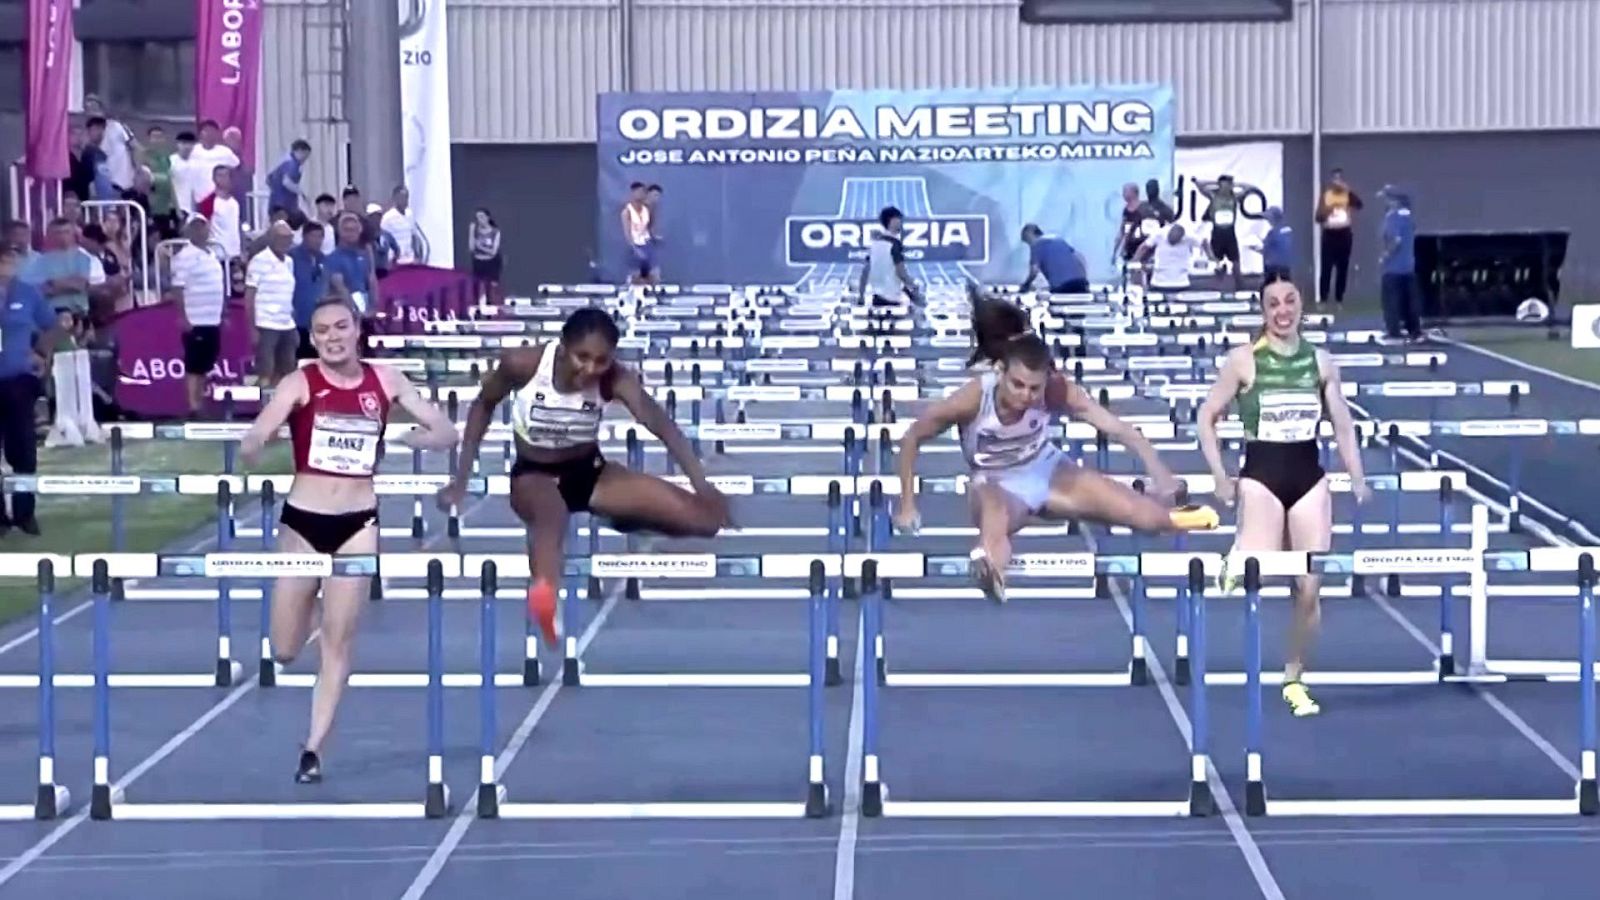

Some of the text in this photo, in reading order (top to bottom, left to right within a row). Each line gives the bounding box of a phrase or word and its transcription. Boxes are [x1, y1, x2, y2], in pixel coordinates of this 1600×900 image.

[618, 101, 1153, 140] ORDIZIA MEETING
[620, 149, 683, 164] JOSE
[688, 149, 801, 164] ANTONIO
[880, 147, 1056, 162] NAZIOARTEKO
[1060, 144, 1153, 159] MITINA
[801, 221, 971, 248] ORDZIA
